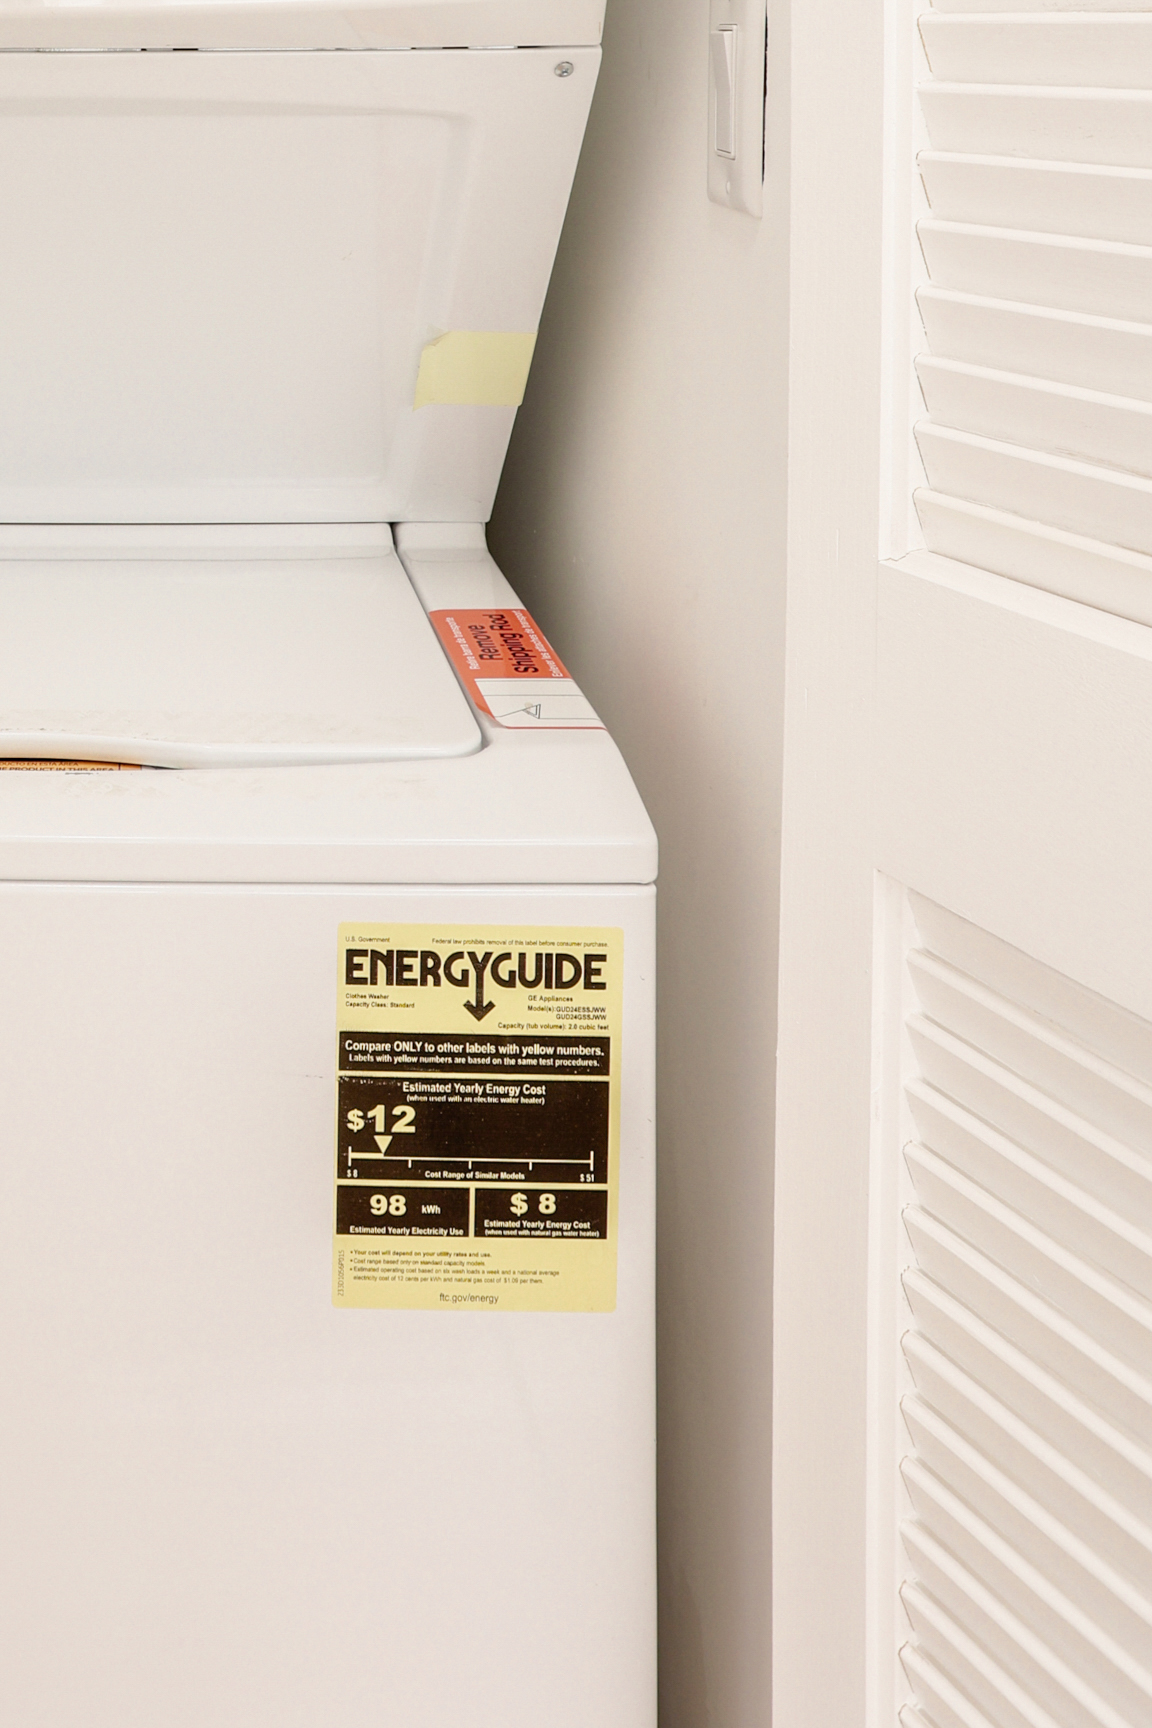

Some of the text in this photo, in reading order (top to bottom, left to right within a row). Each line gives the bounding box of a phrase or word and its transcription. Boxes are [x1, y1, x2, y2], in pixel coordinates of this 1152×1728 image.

[469, 625, 503, 660] Remove
[483, 614, 539, 673] Shipping Rod
[345, 948, 607, 991] ENERGYGUIDE
[345, 1040, 604, 1057] Compare ONLY to other labels with yellow numbers.
[376, 1054, 392, 1062] with
[394, 1055, 418, 1064] yellow
[419, 1055, 452, 1063] numbers
[468, 1056, 490, 1064] based
[504, 1057, 515, 1065] the
[555, 1058, 599, 1067] procedures.
[403, 1082, 546, 1096] Estimated Yearly Energy Cost
[347, 1105, 415, 1132] $12
[443, 1171, 465, 1180] Range
[370, 1194, 440, 1215] 98 kWh
[510, 1192, 556, 1216] $ 8
[388, 1227, 410, 1235] Yearly
[412, 1227, 448, 1236] Electricity
[484, 1220, 590, 1230] Estimated Yearly Energy Cost
[440, 1293, 498, 1304] ftc.gov/energy
